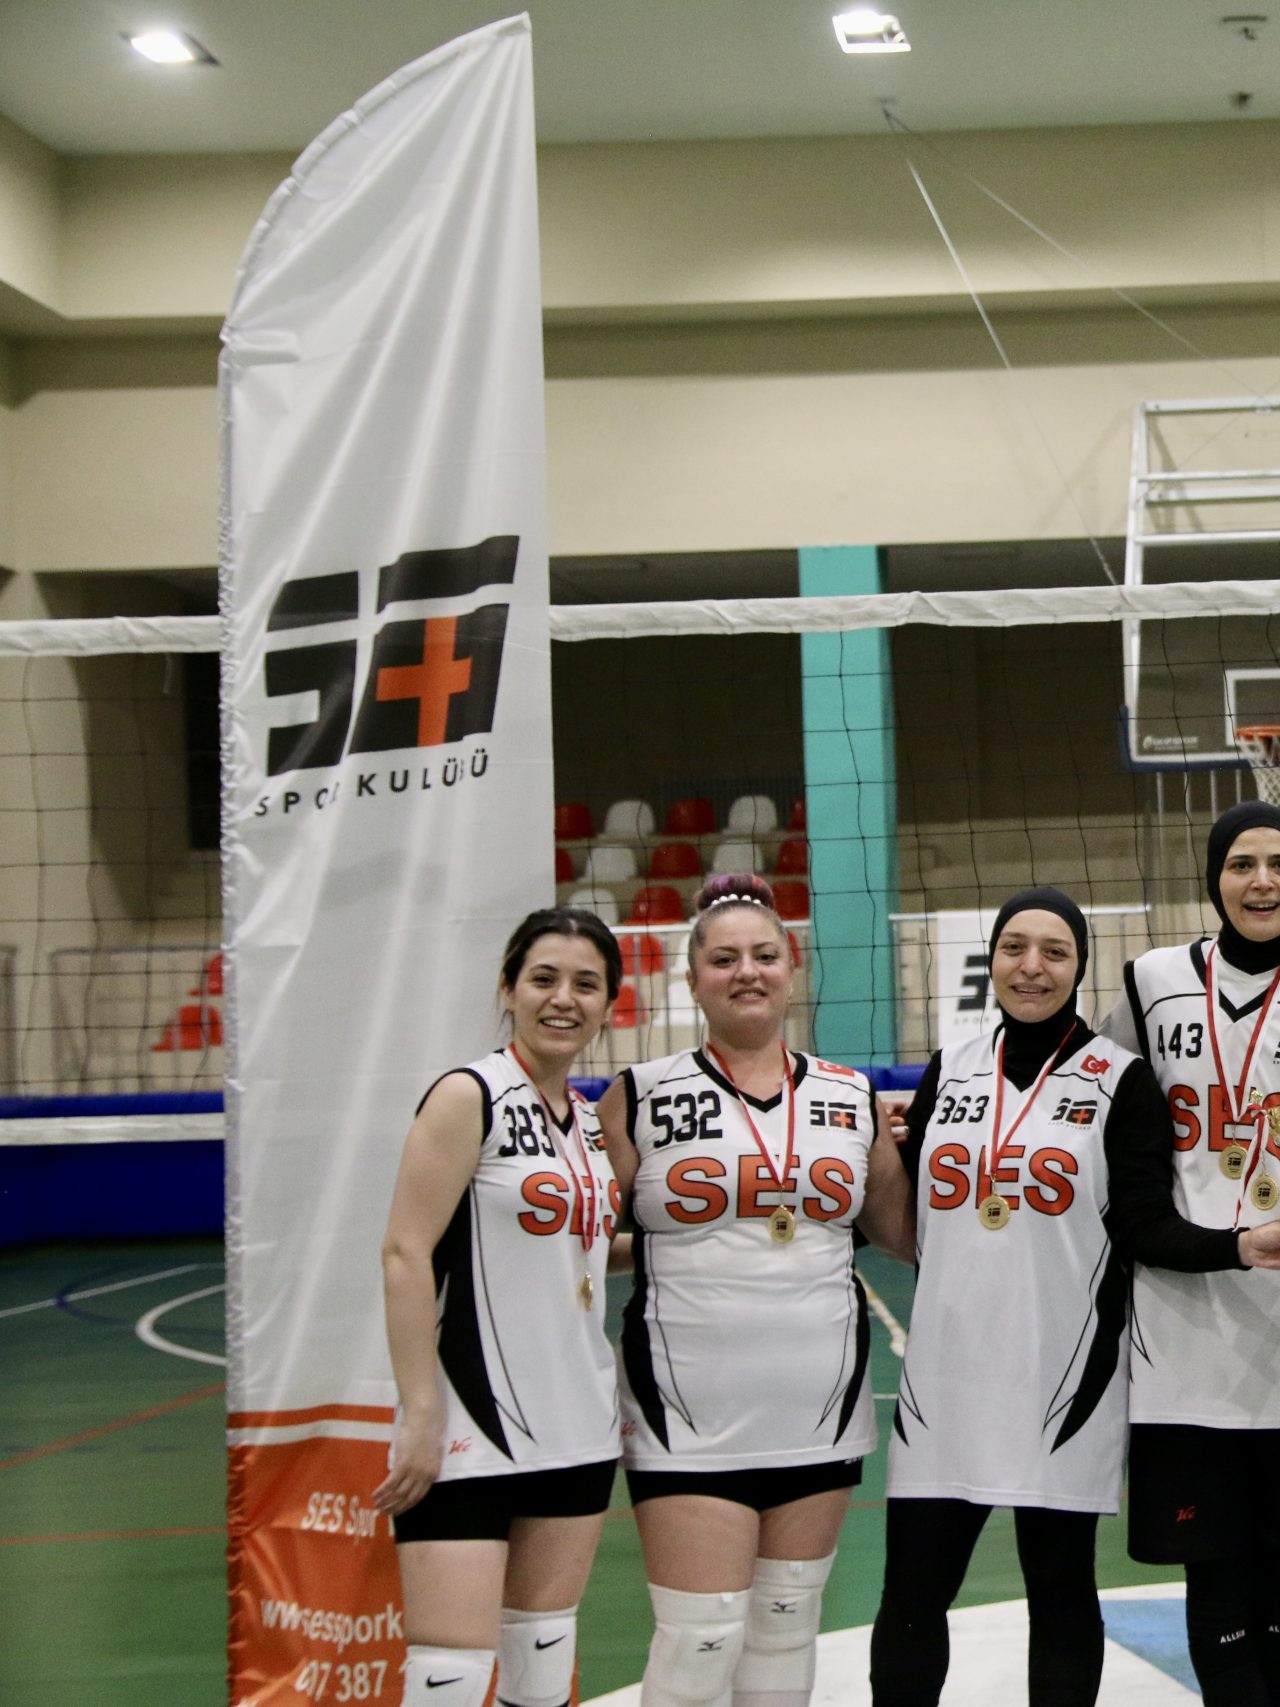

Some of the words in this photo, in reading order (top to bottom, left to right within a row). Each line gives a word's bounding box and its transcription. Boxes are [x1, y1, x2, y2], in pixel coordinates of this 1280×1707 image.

[254, 781, 340, 817] SPO
[357, 748, 489, 798] KULÜÜ
[1157, 1022, 1204, 1062] 443
[498, 1102, 556, 1158] 383
[649, 1089, 723, 1149] 532
[936, 1094, 990, 1125] 363
[665, 1154, 855, 1225] SES
[928, 1142, 1079, 1217] SES
[300, 1491, 346, 1533] SES
[335, 1658, 389, 1702] 387
